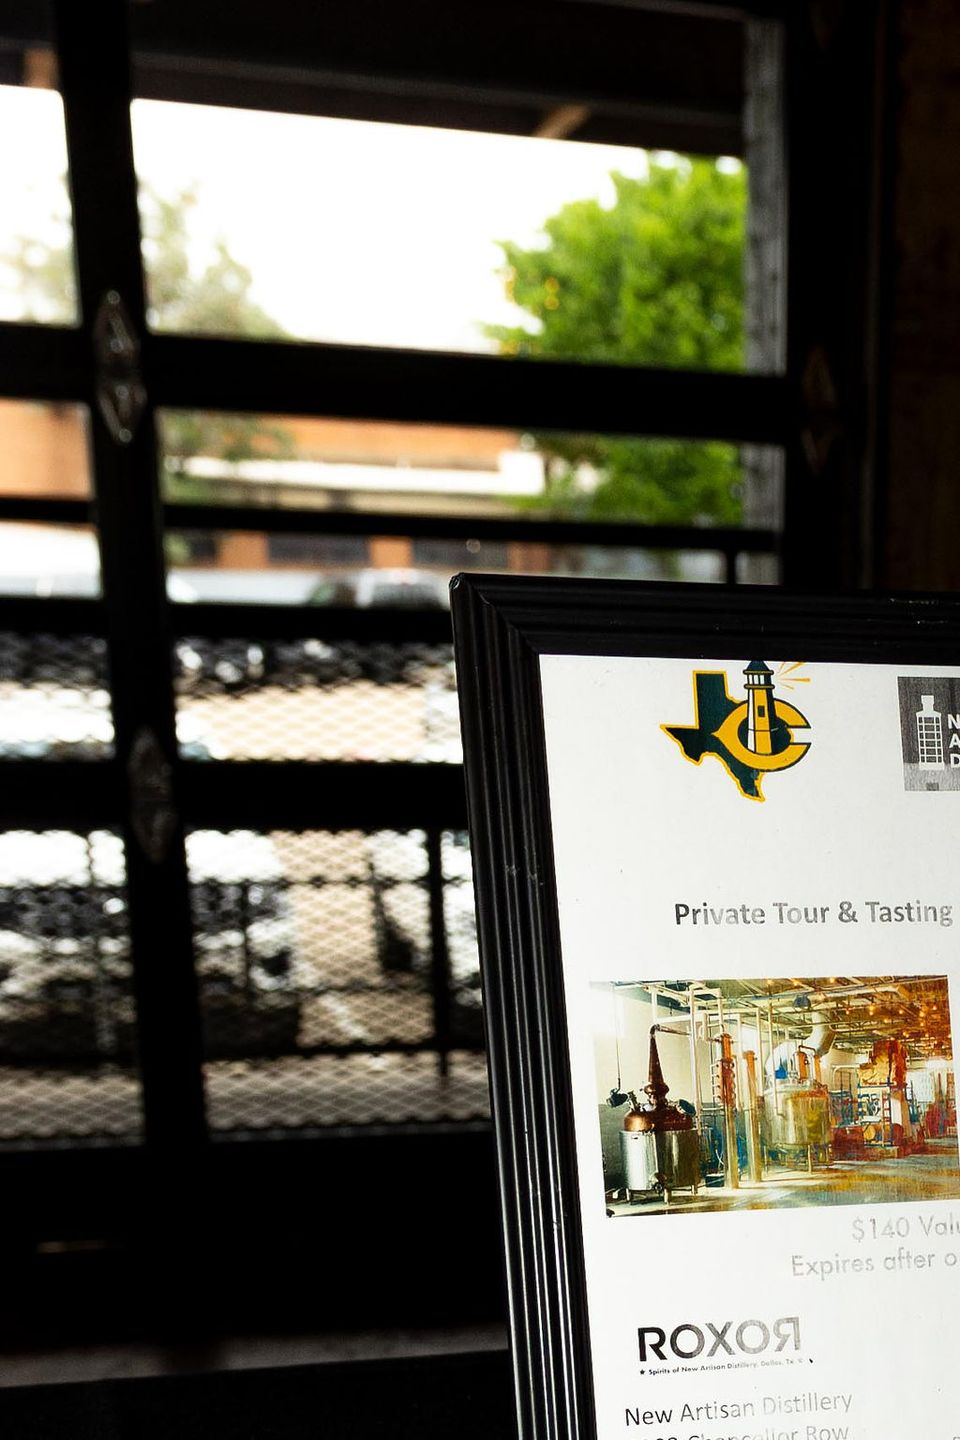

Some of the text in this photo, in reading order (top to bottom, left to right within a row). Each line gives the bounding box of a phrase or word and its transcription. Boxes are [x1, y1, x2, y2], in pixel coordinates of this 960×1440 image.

[674, 902, 766, 926] Private
[772, 901, 830, 925] Tour
[837, 901, 859, 923] &
[864, 900, 954, 928] Tasting
[851, 1216, 910, 1243] $140
[791, 1253, 875, 1281] Expires
[883, 1246, 936, 1271] after
[700, 1363, 726, 1371] Artisan
[624, 1392, 853, 1427] New Artisan Distillery
